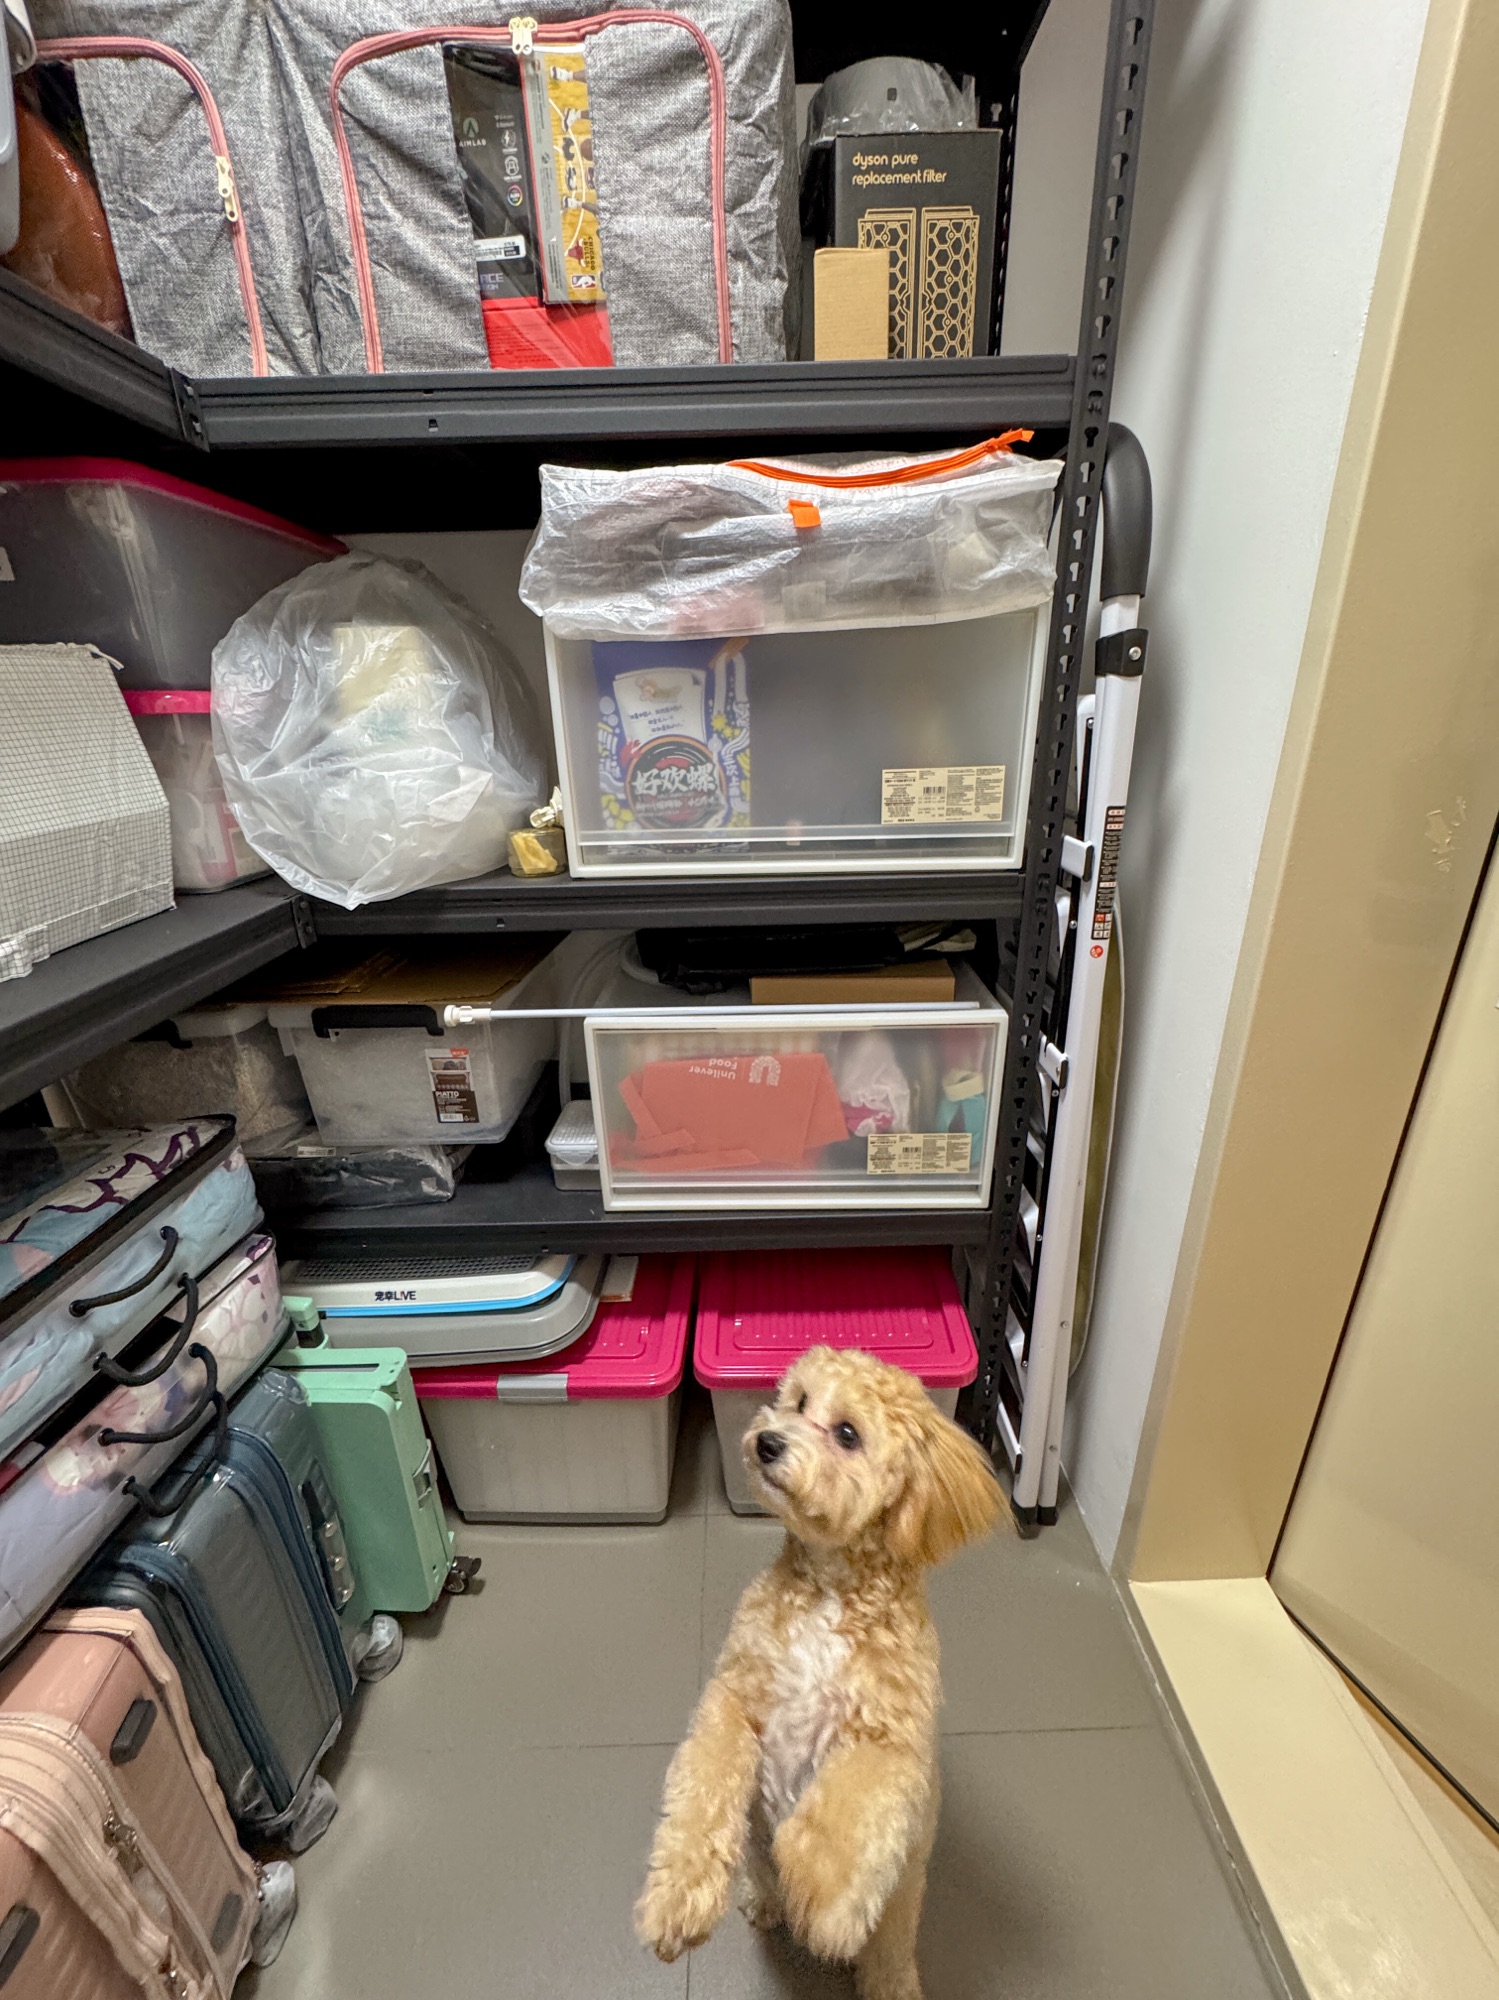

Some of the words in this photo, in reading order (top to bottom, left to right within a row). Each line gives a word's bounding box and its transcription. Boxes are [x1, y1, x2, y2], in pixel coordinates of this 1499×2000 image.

[852, 152, 889, 170] dyson
[891, 153, 918, 169] pure
[852, 170, 921, 188] replacement
[922, 169, 947, 184] filter
[588, 236, 596, 271] CHICAGO
[631, 763, 717, 796] 好欢螺
[688, 1065, 736, 1080] Unilever
[708, 1058, 738, 1070] Food
[435, 1091, 459, 1099] PIATTO
